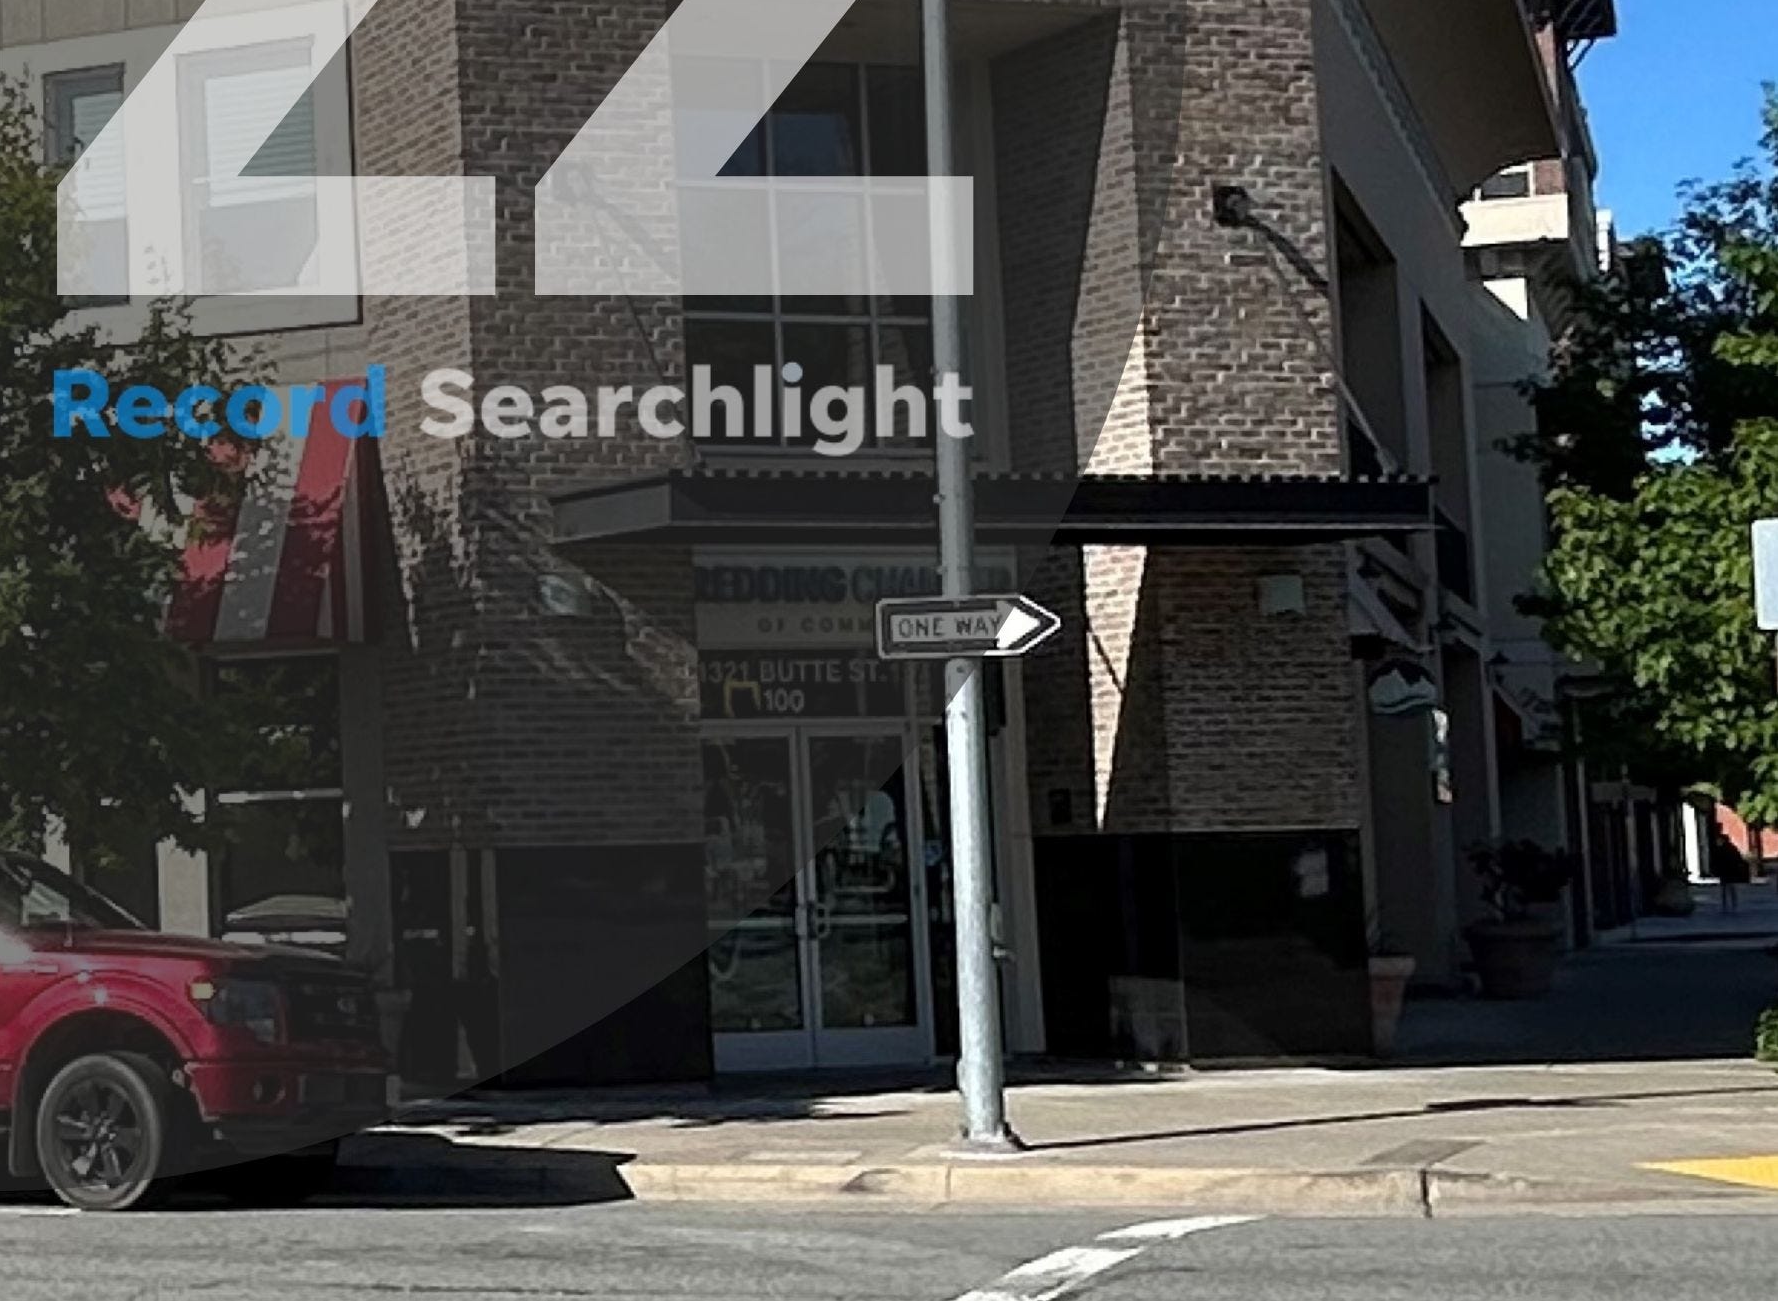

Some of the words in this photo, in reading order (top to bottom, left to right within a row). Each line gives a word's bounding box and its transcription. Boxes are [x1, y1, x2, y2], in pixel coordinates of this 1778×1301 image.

[694, 565, 846, 600] REDDING
[756, 617, 785, 632] OF
[799, 617, 874, 632] COMM
[898, 617, 944, 638] ONE
[955, 615, 1003, 637] WAY
[698, 660, 749, 683] 1321
[759, 658, 842, 681] BUTTE
[848, 657, 888, 681] ST.
[764, 689, 805, 712] 100
